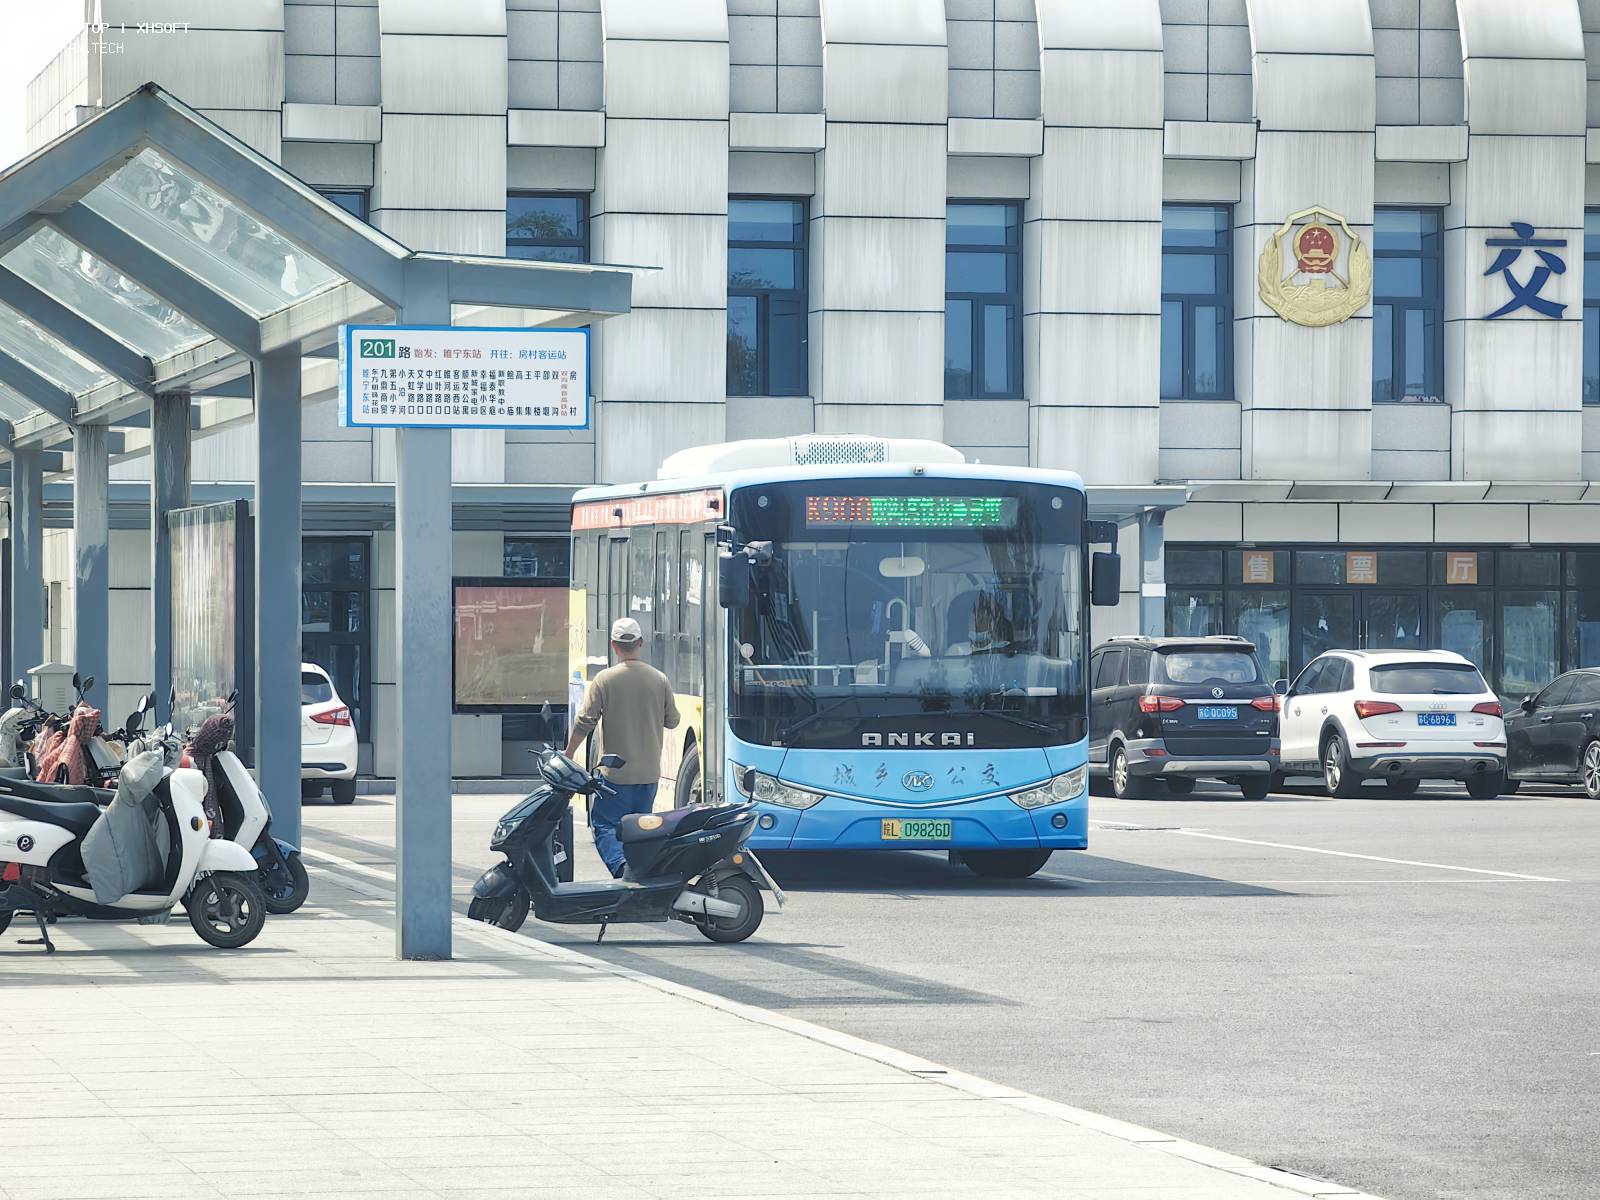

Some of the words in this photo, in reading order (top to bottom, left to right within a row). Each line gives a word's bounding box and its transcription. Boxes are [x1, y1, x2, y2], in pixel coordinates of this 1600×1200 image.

[1485, 222, 1567, 320] 交
[389, 368, 398, 415] 第五小学
[407, 368, 416, 415] 天虹路口
[416, 368, 425, 415] 文学路口
[425, 368, 434, 415] 中山路口
[434, 368, 443, 415] 红叶路口
[452, 368, 461, 416] 客运西站
[479, 369, 488, 416] 幸福小区
[861, 732, 975, 746] ANKAI
